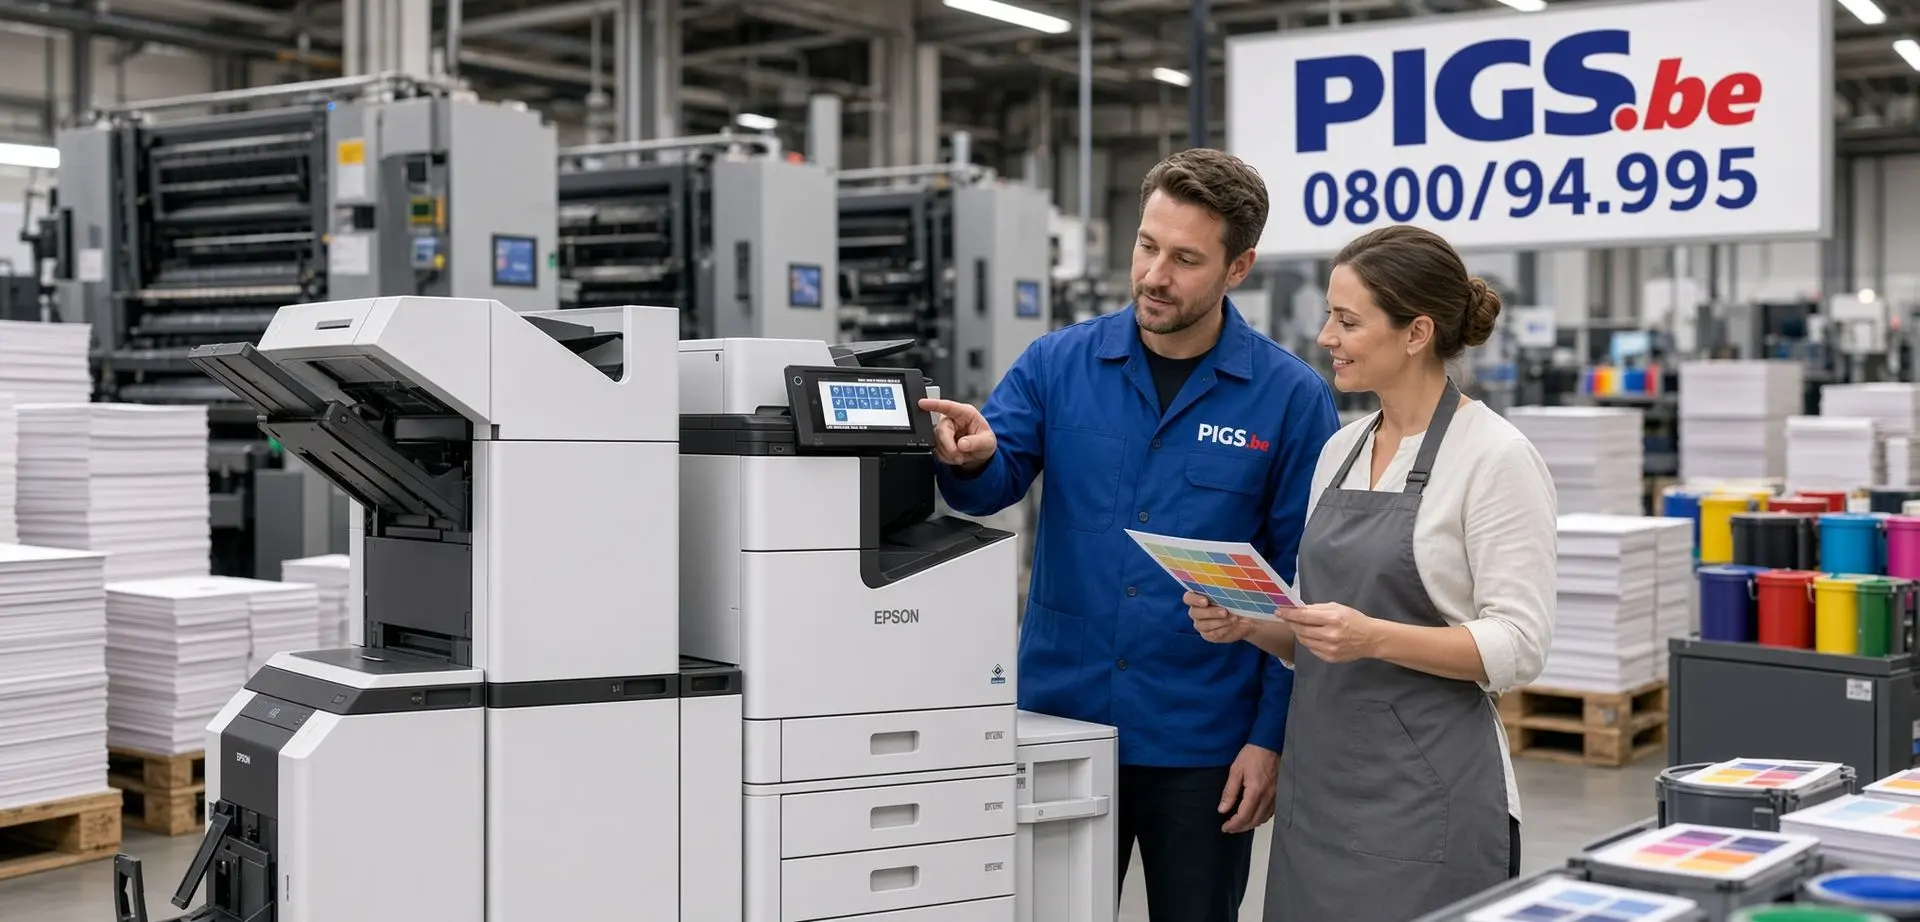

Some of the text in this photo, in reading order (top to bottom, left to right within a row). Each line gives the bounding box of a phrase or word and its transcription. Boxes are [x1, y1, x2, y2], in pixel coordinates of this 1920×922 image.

[1295, 29, 1762, 153] PIGS.be
[1303, 146, 1758, 226] 0800/94.995
[1198, 423, 1270, 452] PIGS.be
[874, 608, 919, 625] EPSON
[236, 752, 250, 764] EPSON
